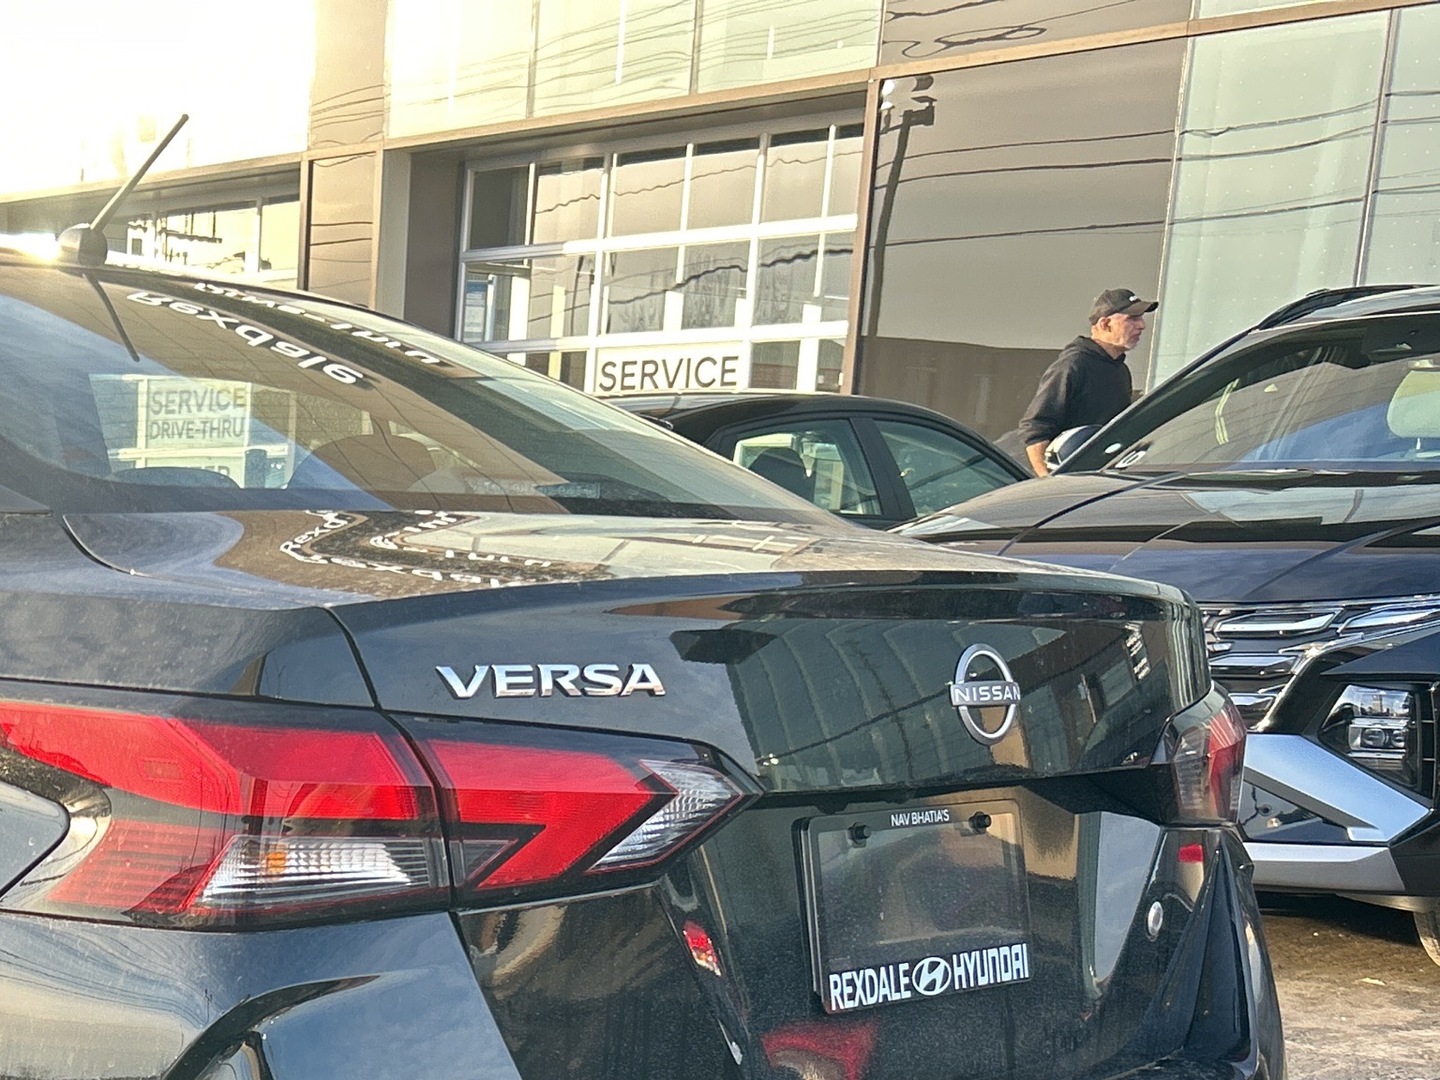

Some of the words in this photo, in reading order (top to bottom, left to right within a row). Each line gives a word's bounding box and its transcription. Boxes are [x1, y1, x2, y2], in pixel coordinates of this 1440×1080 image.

[598, 355, 740, 392] SERVICE
[150, 386, 247, 416] SERVICE
[149, 416, 245, 440] DRIVE-THRU
[435, 663, 667, 699] VERSA
[953, 685, 1021, 703] NISSAN
[891, 812, 911, 827] NAV
[912, 808, 950, 825] BHATIA'S
[829, 962, 912, 1011] REXDALE
[952, 943, 1030, 990] HYUNDAI
